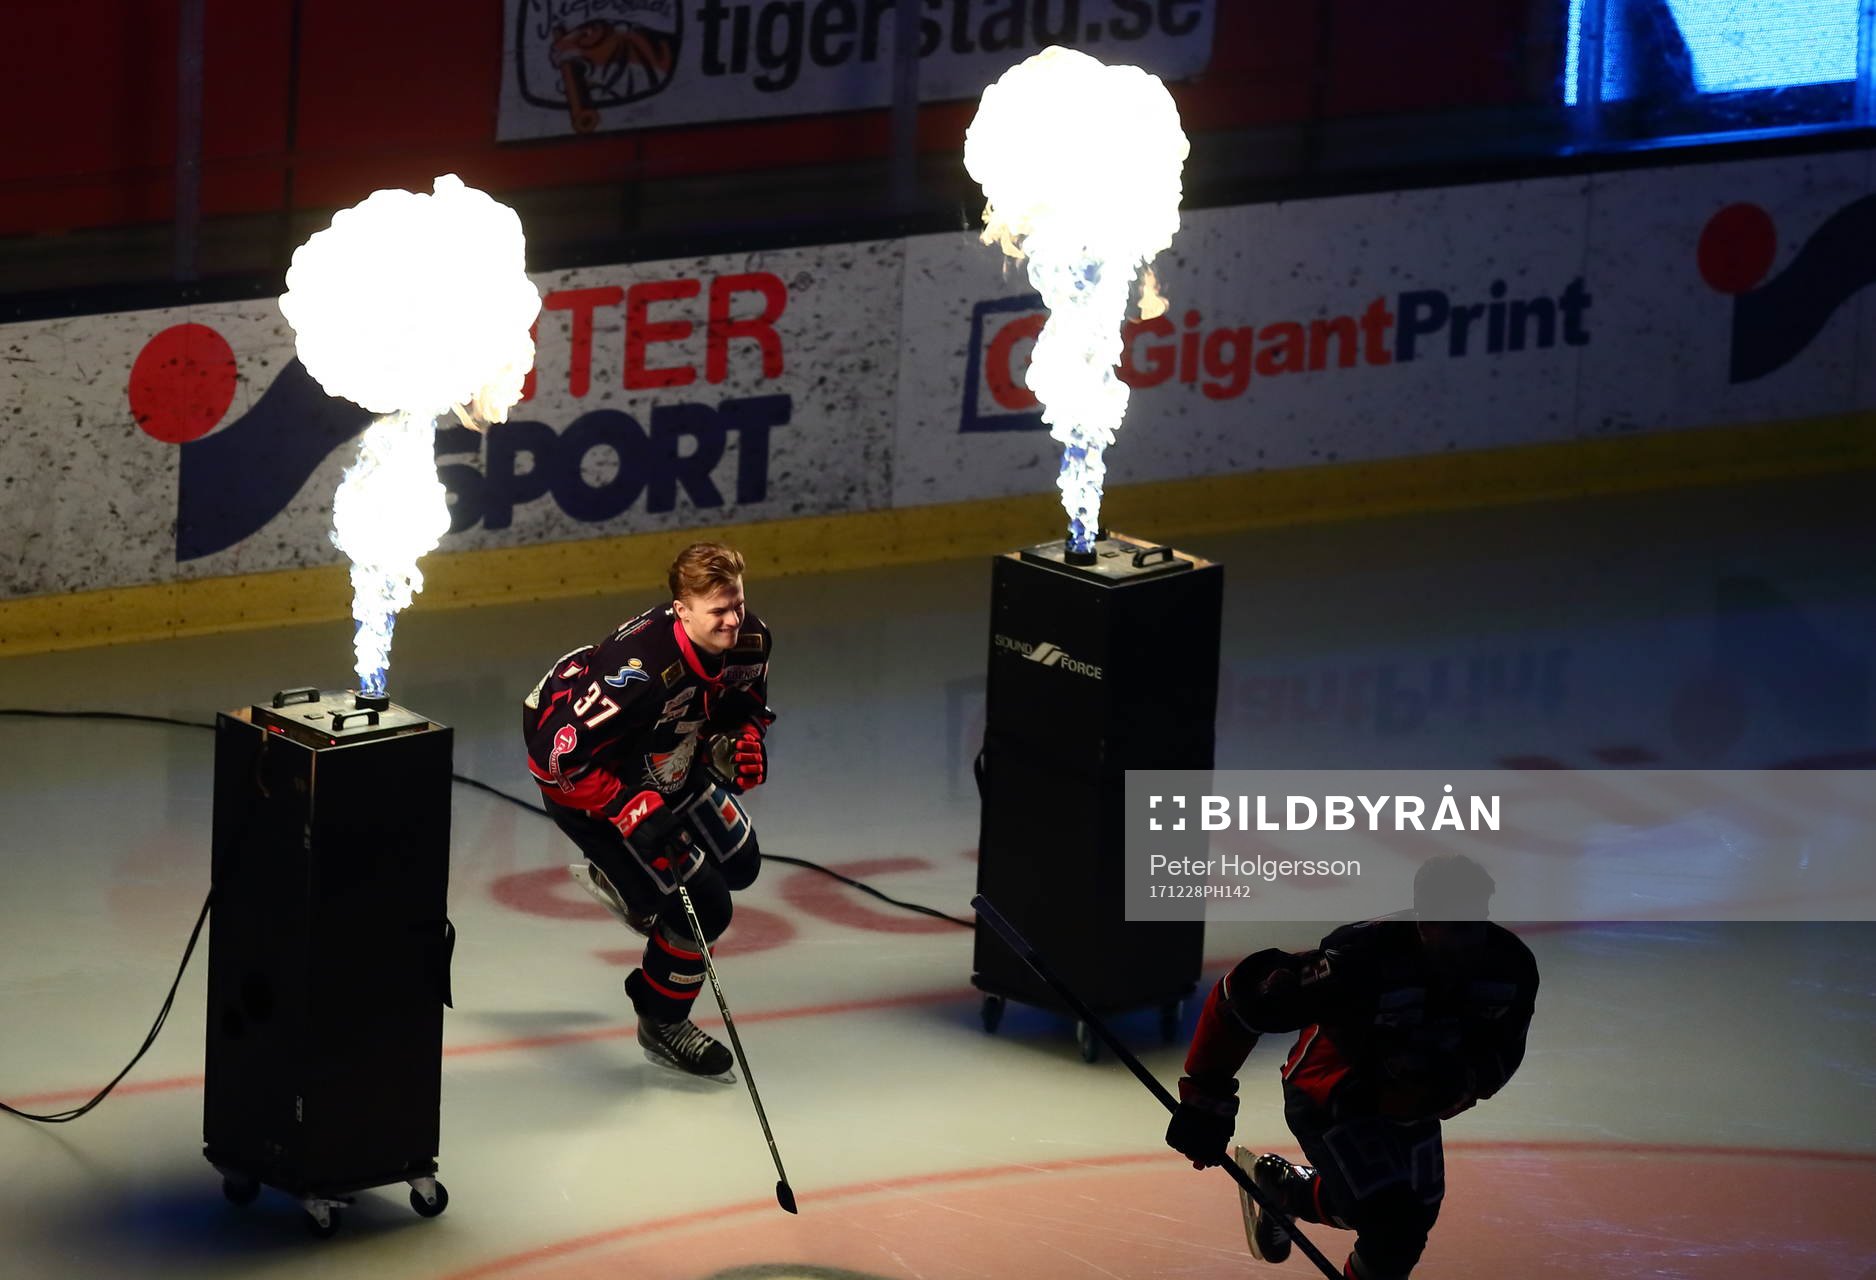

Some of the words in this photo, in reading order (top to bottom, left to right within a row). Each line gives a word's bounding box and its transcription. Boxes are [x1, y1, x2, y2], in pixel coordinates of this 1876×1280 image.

[995, 634, 1033, 654] SOUND
[1060, 656, 1103, 680] FORCE
[573, 680, 621, 728] 37
